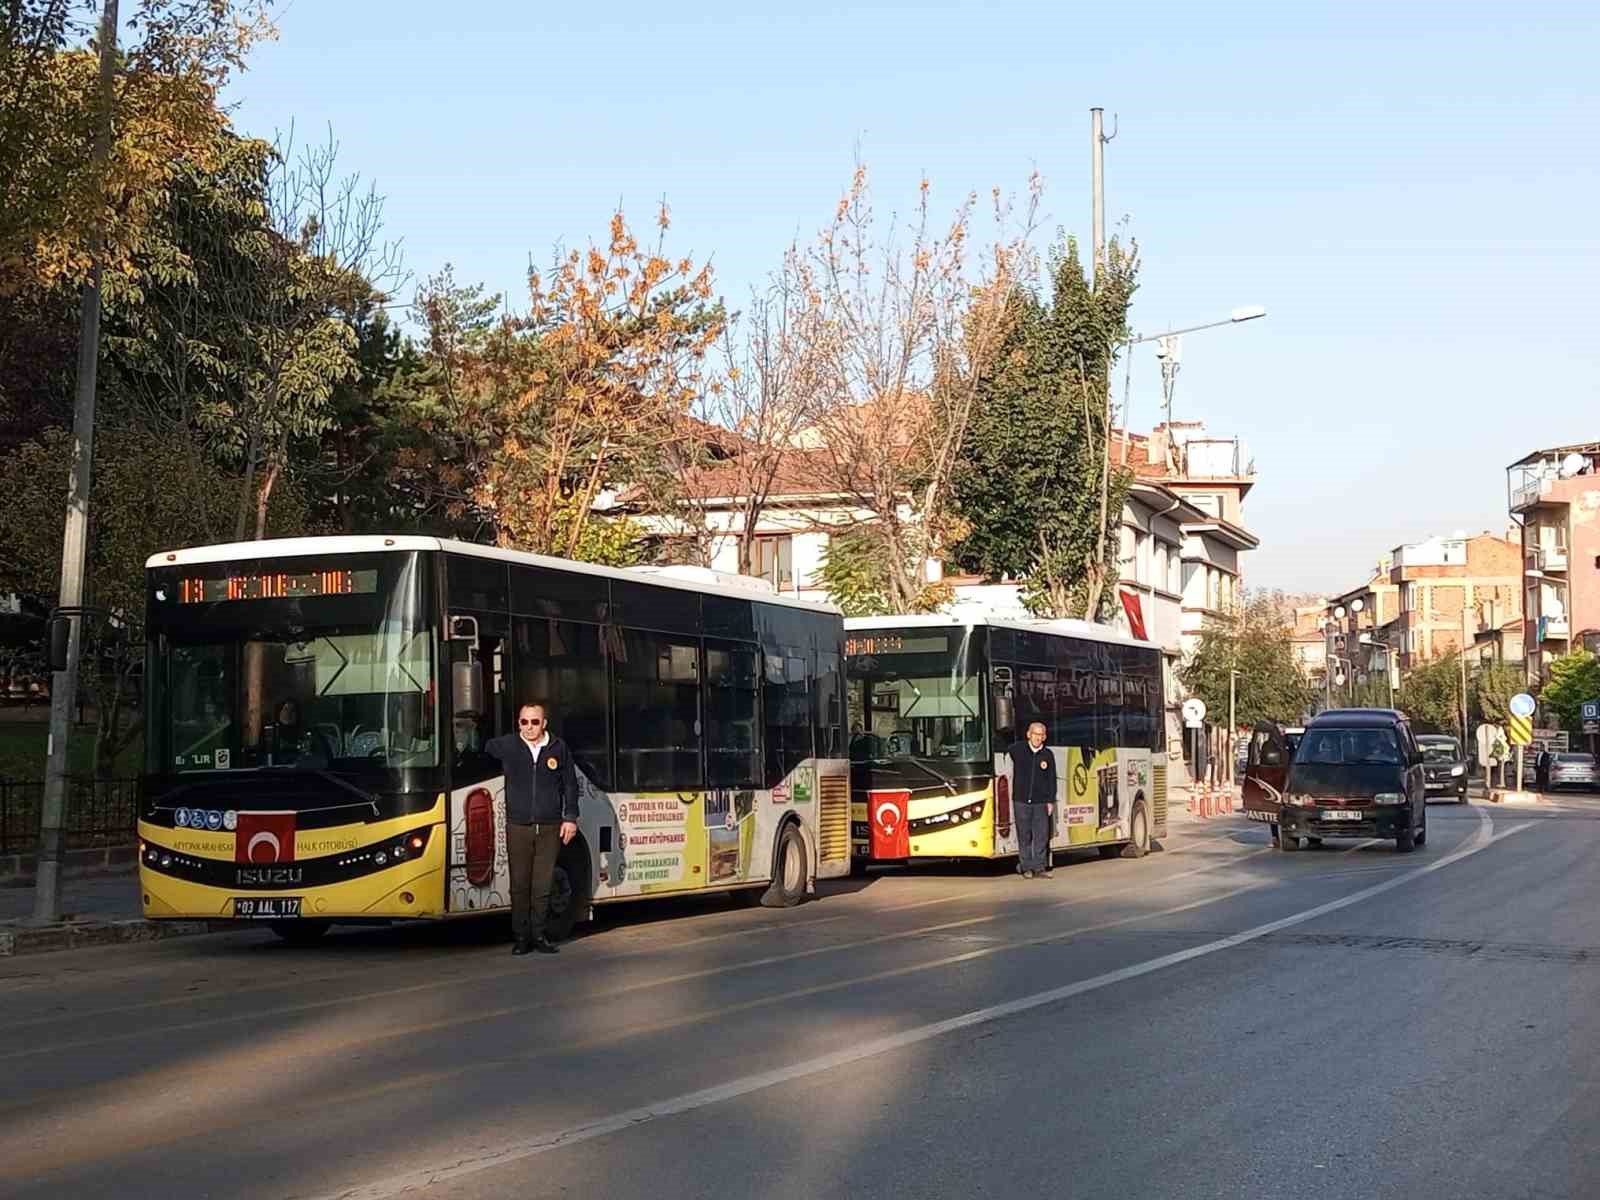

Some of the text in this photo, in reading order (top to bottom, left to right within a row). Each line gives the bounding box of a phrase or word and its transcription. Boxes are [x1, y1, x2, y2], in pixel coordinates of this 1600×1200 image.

[236, 868, 303, 884] ISUZU
[241, 900, 298, 914] 03 AAL 117
